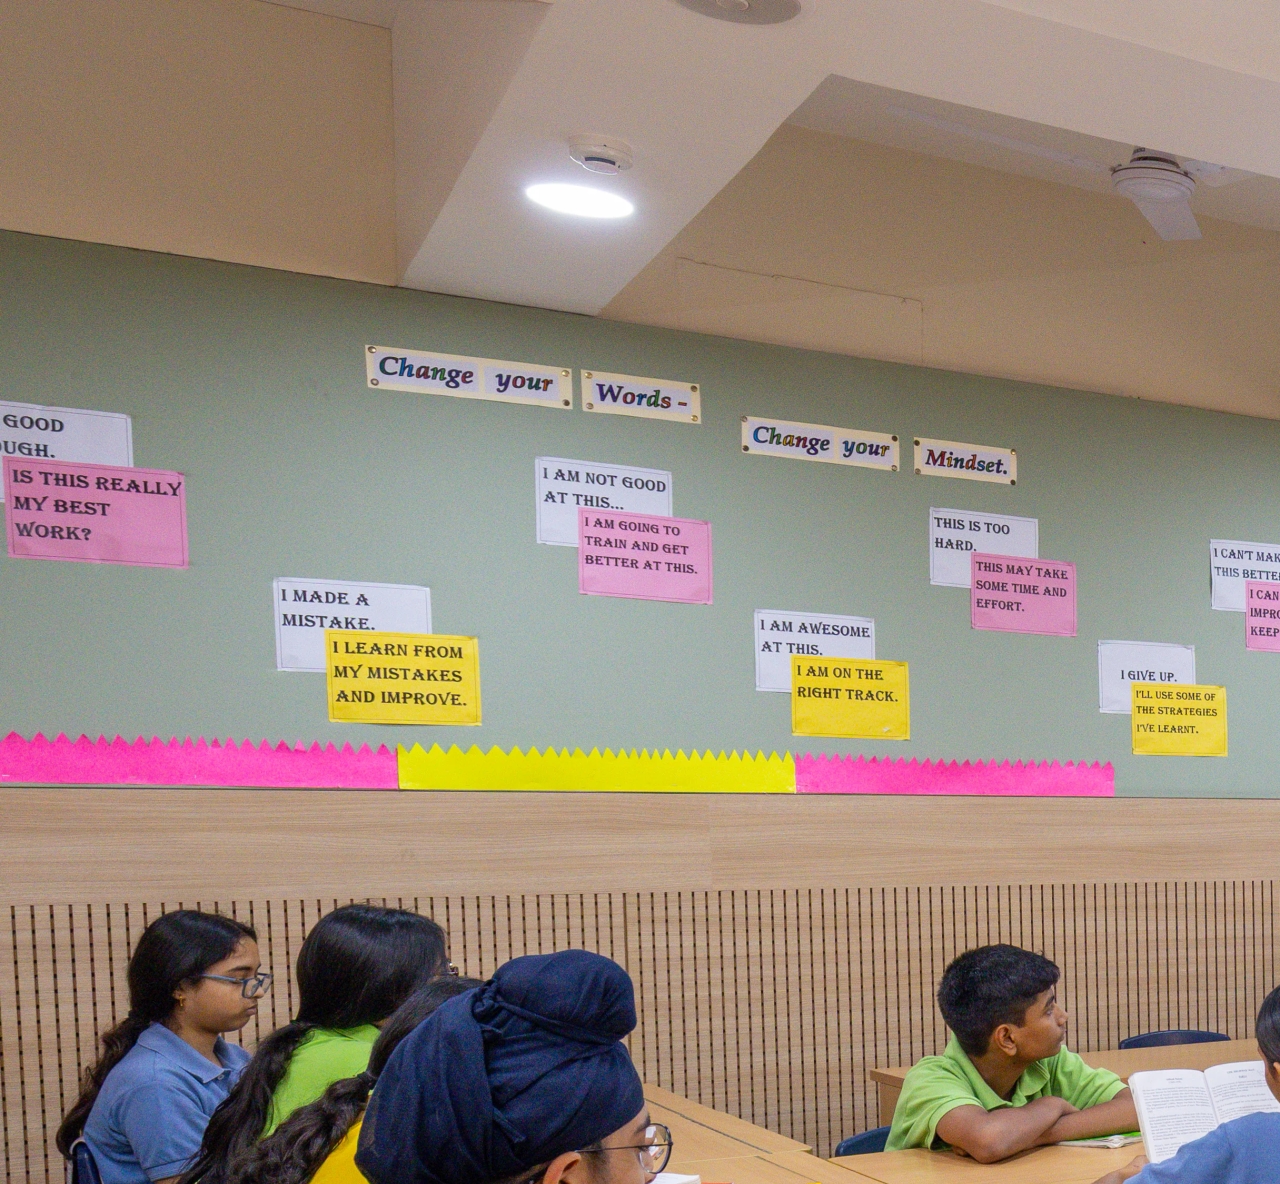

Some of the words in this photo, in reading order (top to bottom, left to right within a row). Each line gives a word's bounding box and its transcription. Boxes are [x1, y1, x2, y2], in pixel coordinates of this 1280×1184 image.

[379, 356, 474, 388] Change
[495, 373, 554, 393] your
[596, 383, 672, 409] Words
[3, 414, 64, 432] GOOD
[0, 440, 55, 458] UGH.
[753, 426, 830, 455] Change
[842, 440, 890, 458] your
[925, 449, 1007, 474] Mindset.
[12, 469, 33, 484] IS
[38, 471, 90, 488] THIS
[95, 477, 182, 496] REALLY
[543, 468, 548, 479] I
[553, 469, 580, 482] AM
[585, 472, 618, 486] NOT
[622, 476, 666, 492] GOOD
[13, 496, 49, 511] MY
[53, 499, 111, 516] BEST
[544, 491, 568, 503] AT
[572, 493, 624, 510] THIS...
[15, 521, 92, 541] WORK?
[585, 517, 589, 526] I
[593, 518, 615, 529] AM
[618, 521, 660, 534] GOING
[663, 525, 681, 536] TO
[934, 517, 965, 530] THIS
[969, 521, 981, 531] IS
[984, 522, 1010, 534] TOO
[584, 535, 627, 549] TRAIN
[631, 541, 659, 552] AND
[662, 544, 689, 555] GET
[935, 537, 977, 551] HARD.
[1214, 548, 1218, 558] I
[1221, 548, 1254, 560] CAN'T
[585, 554, 639, 569] BETTER
[643, 560, 662, 571] AT
[665, 562, 698, 574] THIS.
[976, 561, 1003, 573] THIS
[1006, 564, 1034, 576] MAY
[1035, 567, 1068, 579] TAKE
[1214, 566, 1239, 577] THIS
[976, 580, 1009, 592] SOME
[1011, 583, 1040, 595] TIME
[1043, 586, 1067, 597] AND
[1250, 589, 1254, 599] I
[1256, 590, 1279, 600] CAN
[281, 589, 287, 601] I
[293, 589, 350, 605] MADE
[355, 593, 370, 606] A
[976, 598, 1025, 612] EFFORT.
[282, 613, 375, 630] MISTAKE.
[761, 619, 765, 630] I
[770, 620, 793, 633] AM
[798, 622, 870, 638] AWESOME
[1251, 626, 1280, 637] KEEP
[333, 641, 339, 653] I
[345, 642, 408, 656] LEARN
[413, 645, 463, 659] FROM
[761, 641, 783, 652] AT
[786, 643, 823, 656] THIS.
[333, 664, 363, 678] MY
[367, 667, 463, 682] MISTAKES
[797, 665, 802, 676] I
[806, 666, 829, 677] AM
[833, 667, 852, 678] ON
[855, 668, 884, 680] THE
[1121, 670, 1125, 679] I
[1128, 670, 1156, 681] GIVE
[1159, 672, 1177, 682] UP.
[336, 690, 375, 703] AND
[381, 691, 467, 706] IMPROVE.
[797, 686, 842, 699] RIGHT
[845, 689, 898, 702] TRACK.
[1136, 690, 1153, 699] I'LL
[1155, 691, 1174, 699] USE
[1176, 692, 1202, 701] SOME
[1204, 693, 1216, 701] OF
[1136, 706, 1155, 714] THE
[1158, 706, 1218, 716] STRATEGIES
[1137, 723, 1155, 733] I'VE
[1158, 725, 1199, 734] LEARNT.
